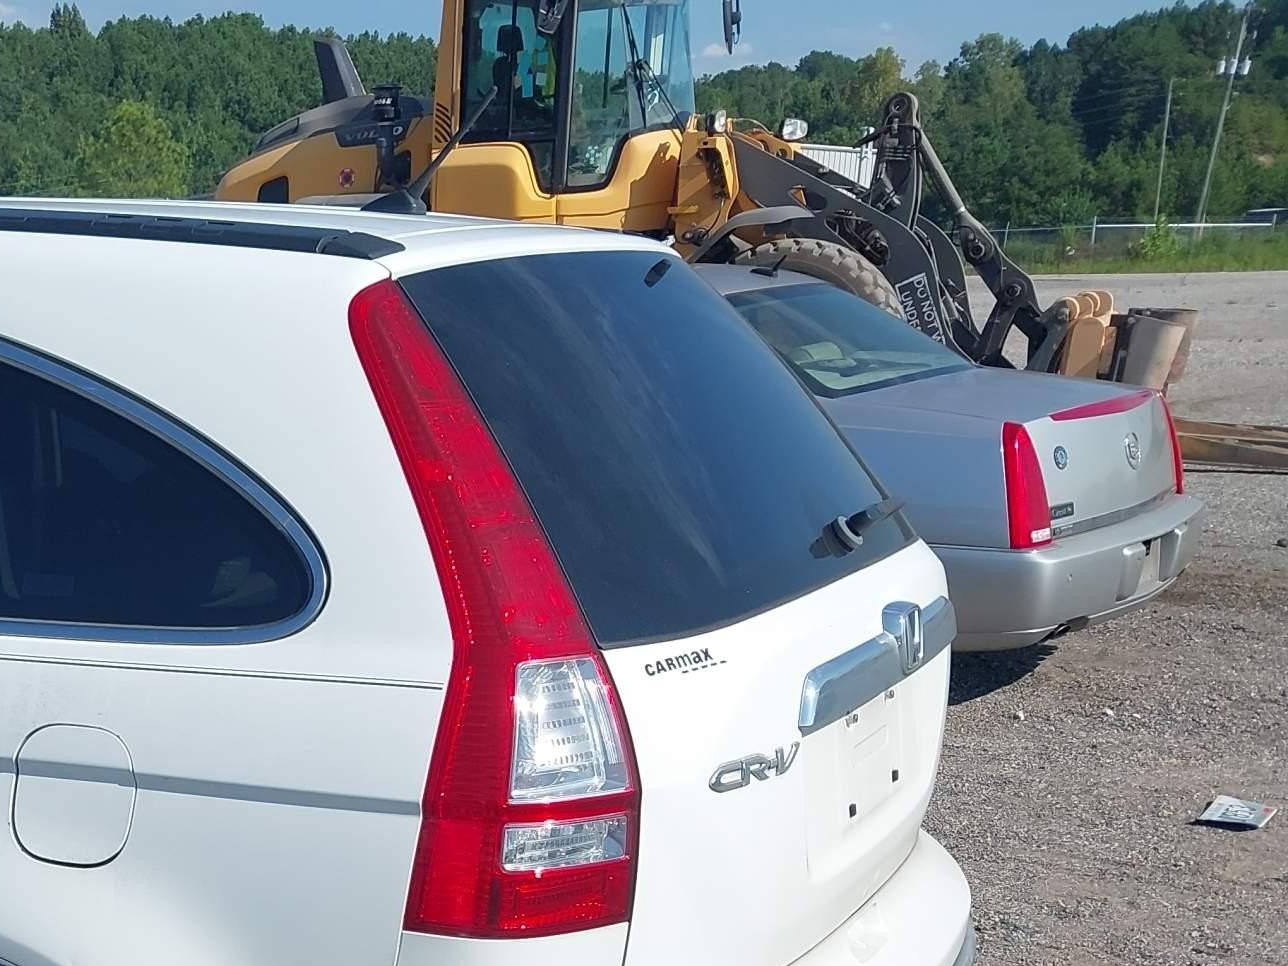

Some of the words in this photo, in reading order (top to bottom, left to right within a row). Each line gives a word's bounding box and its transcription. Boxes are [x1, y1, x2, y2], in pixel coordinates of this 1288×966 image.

[920, 300, 938, 328] NOT
[644, 647, 714, 677] CARmax
[708, 741, 801, 794] CR-V
